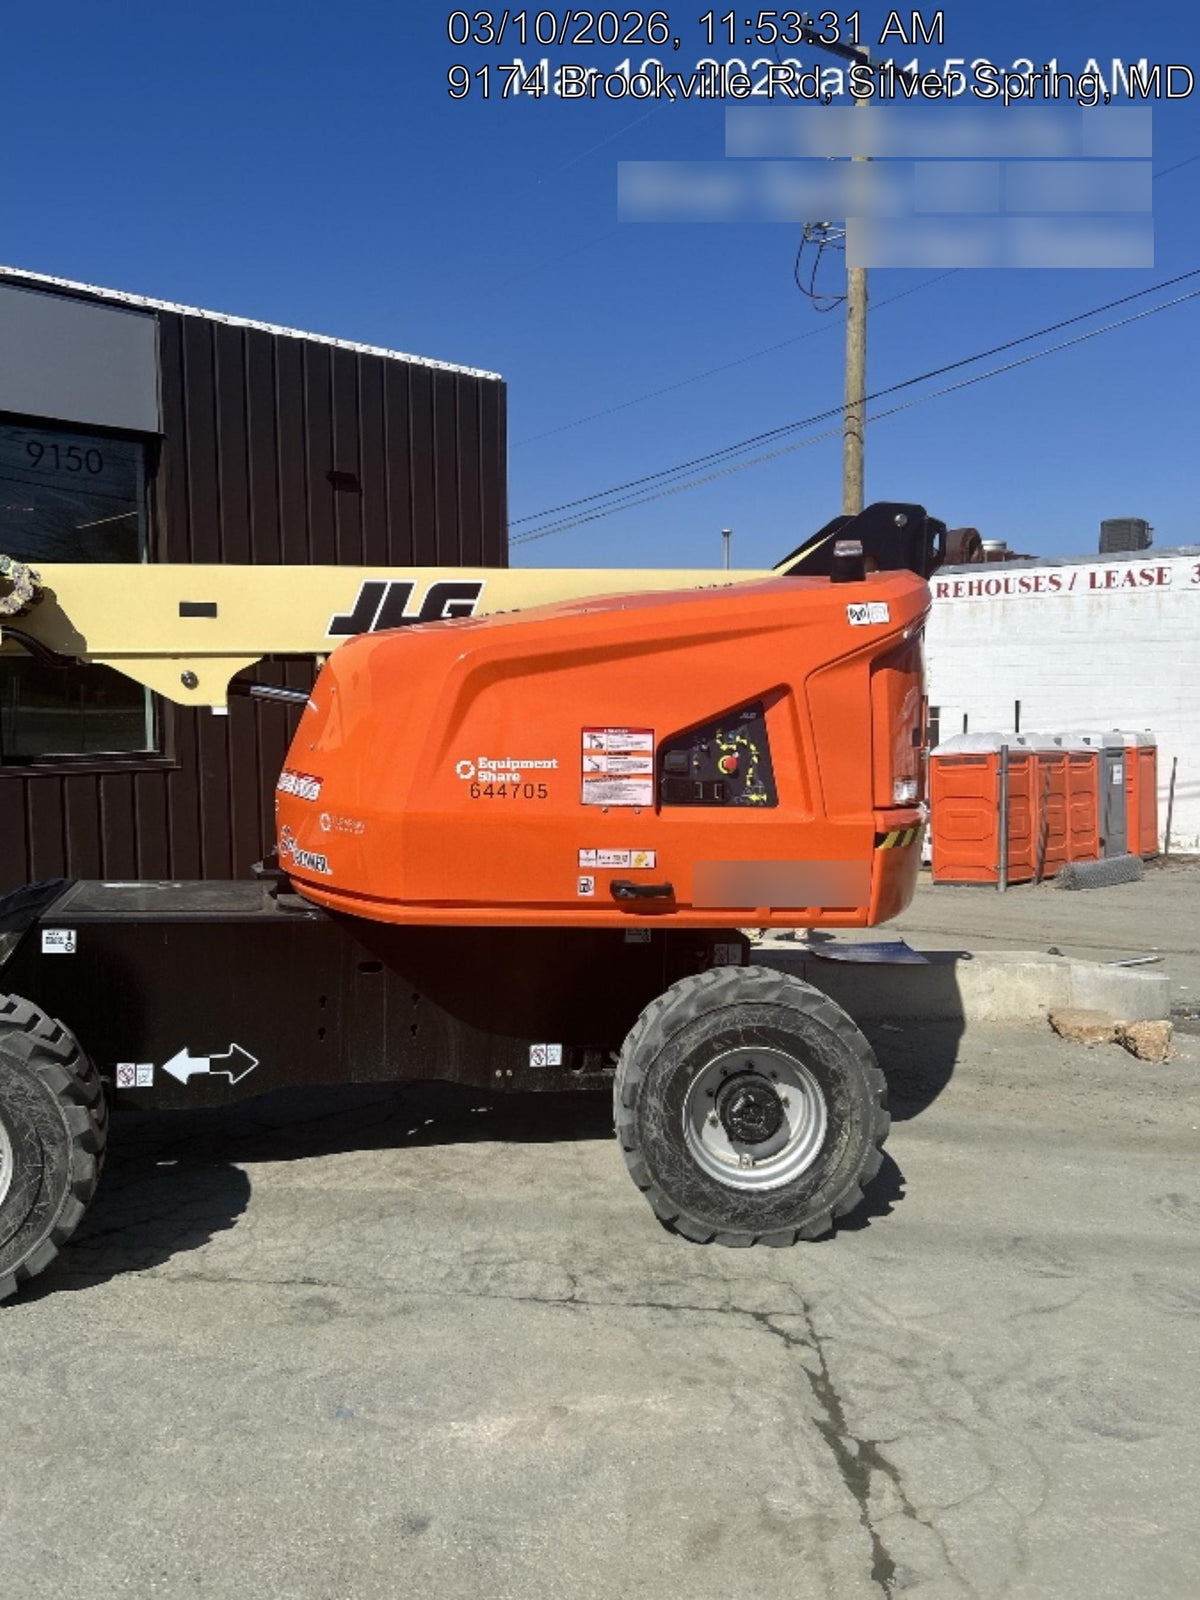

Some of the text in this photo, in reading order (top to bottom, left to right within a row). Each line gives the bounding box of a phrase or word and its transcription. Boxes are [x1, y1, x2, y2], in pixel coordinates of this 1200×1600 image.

[26, 441, 104, 475] 9150
[1089, 566, 1172, 590] LEASE
[326, 580, 486, 637] JLG
[478, 757, 558, 771] Equipment
[478, 771, 520, 783] Share
[470, 782, 548, 799] 644705
